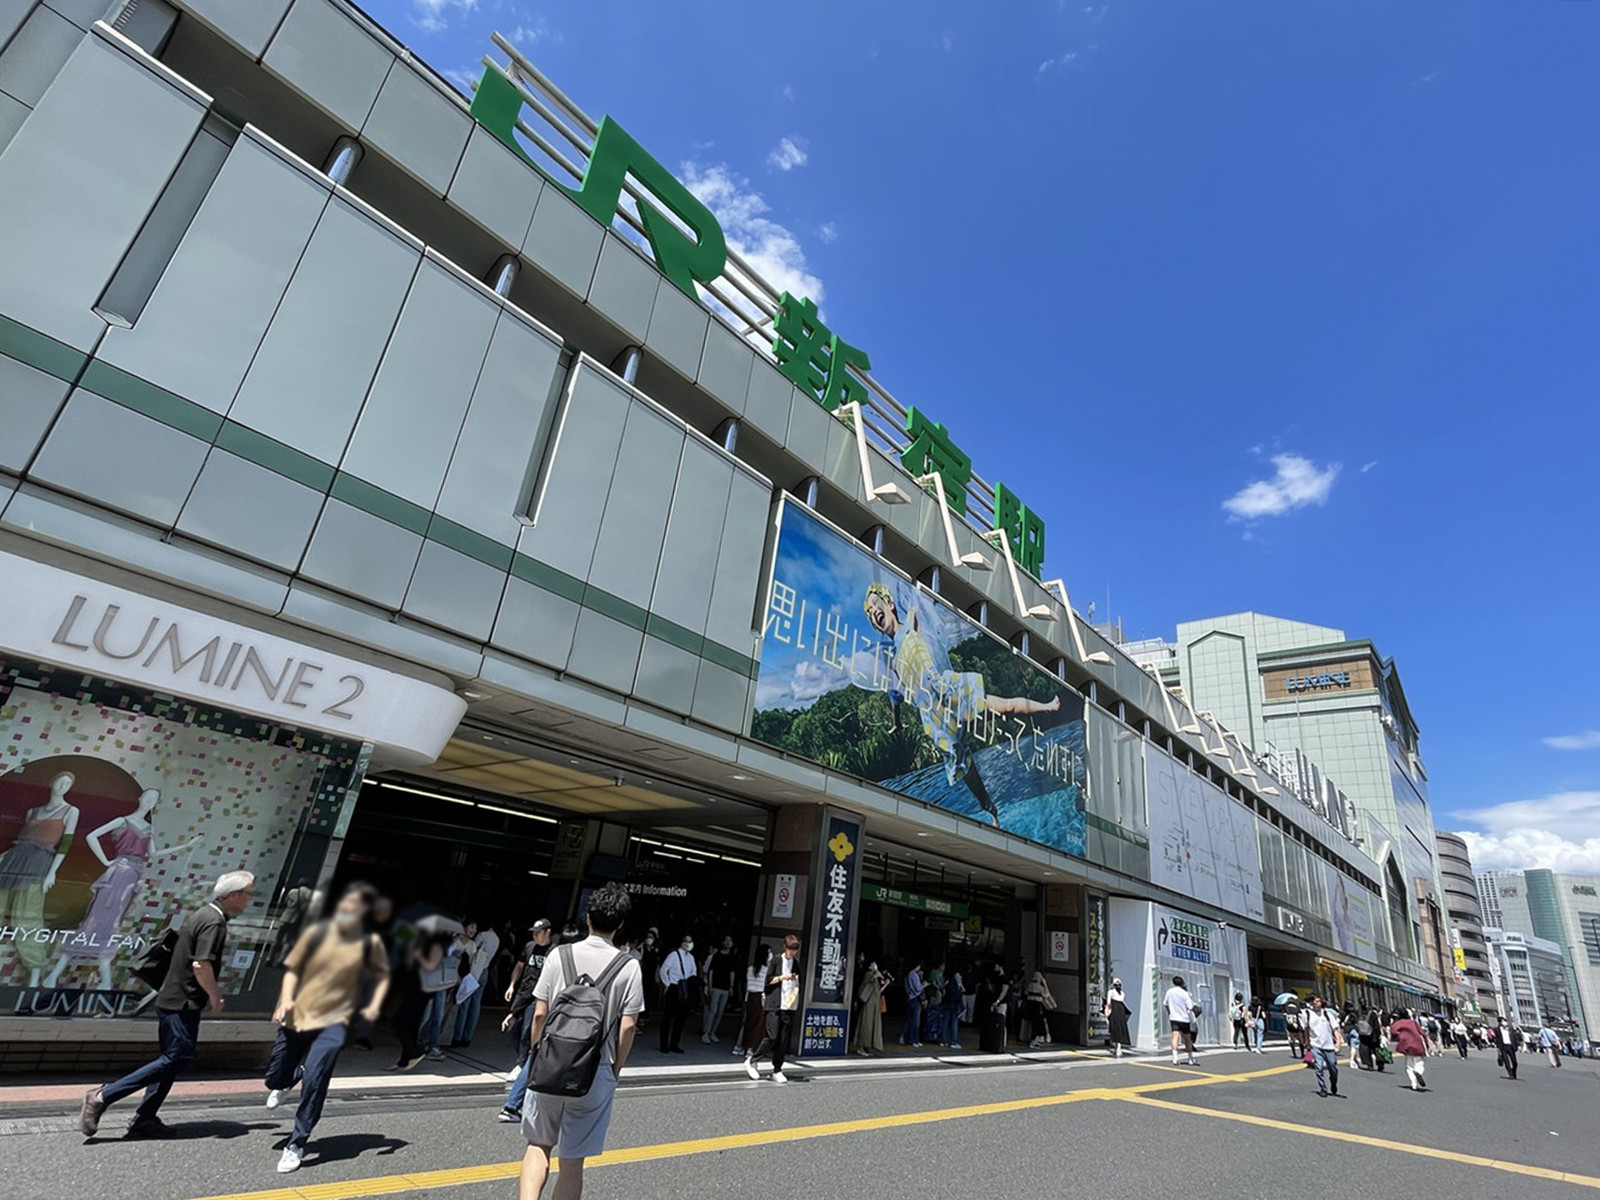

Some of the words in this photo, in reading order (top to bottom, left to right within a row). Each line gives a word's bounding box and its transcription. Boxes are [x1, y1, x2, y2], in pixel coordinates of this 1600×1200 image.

[469, 64, 727, 300] JR
[772, 290, 1046, 578] 新宿駅
[52, 595, 324, 709] LUMINE
[321, 674, 365, 720] 2
[1286, 669, 1350, 691] LUMINE
[820, 864, 847, 990] 住友不動産
[876, 887, 887, 898] JR
[0, 926, 100, 947] HYGITAL
[14, 990, 140, 1017] LUMINE
